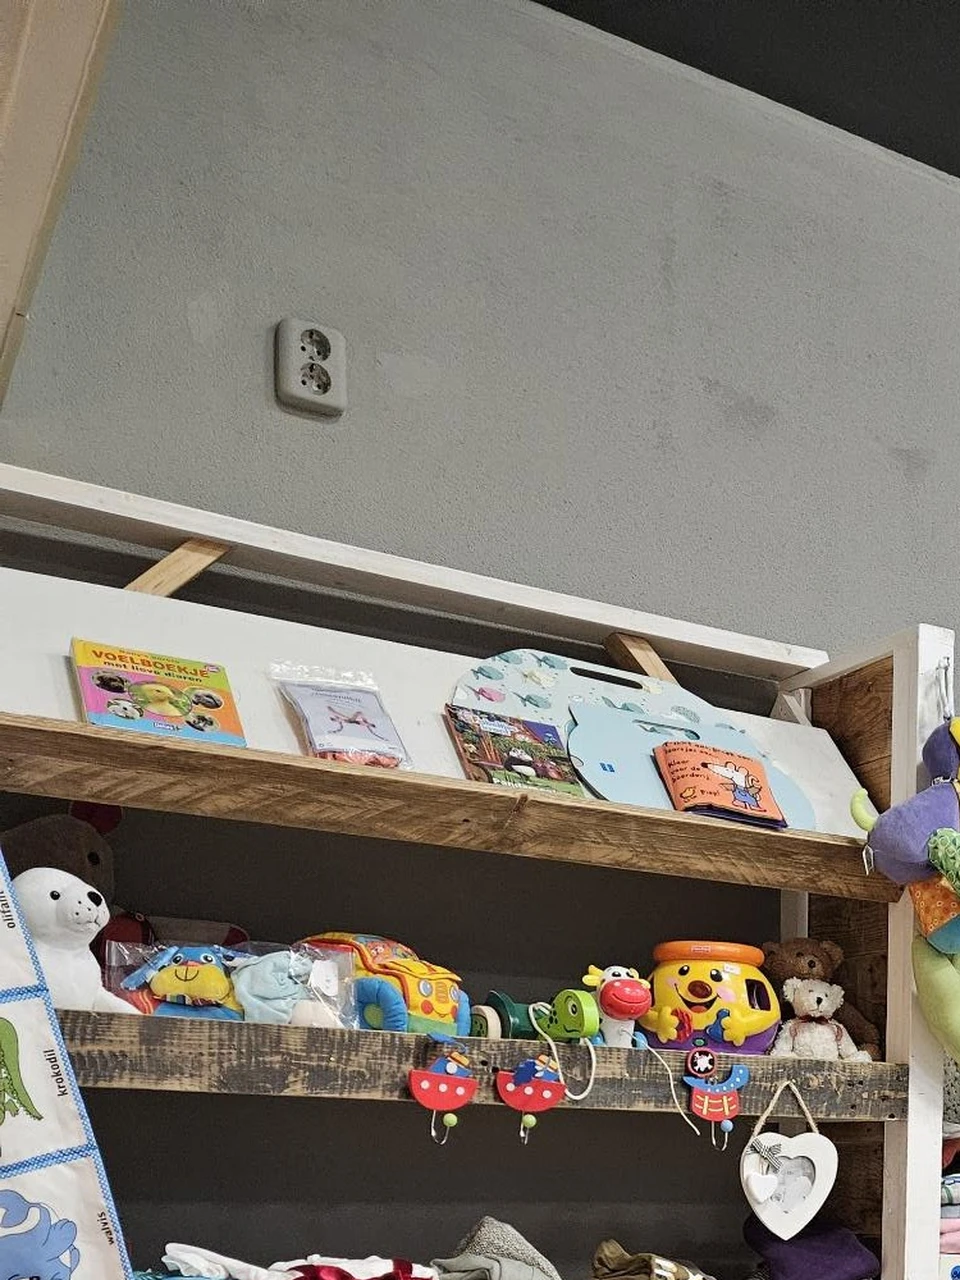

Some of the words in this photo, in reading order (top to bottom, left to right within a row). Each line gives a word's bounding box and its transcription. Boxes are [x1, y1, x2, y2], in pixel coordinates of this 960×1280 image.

[92, 650, 210, 678] VOELBOEKJE
[104, 661, 127, 670] met
[131, 664, 161, 675] lieve
[164, 672, 203, 683] dieren
[43, 1049, 69, 1097] krokodil
[97, 1211, 115, 1245] walvis
